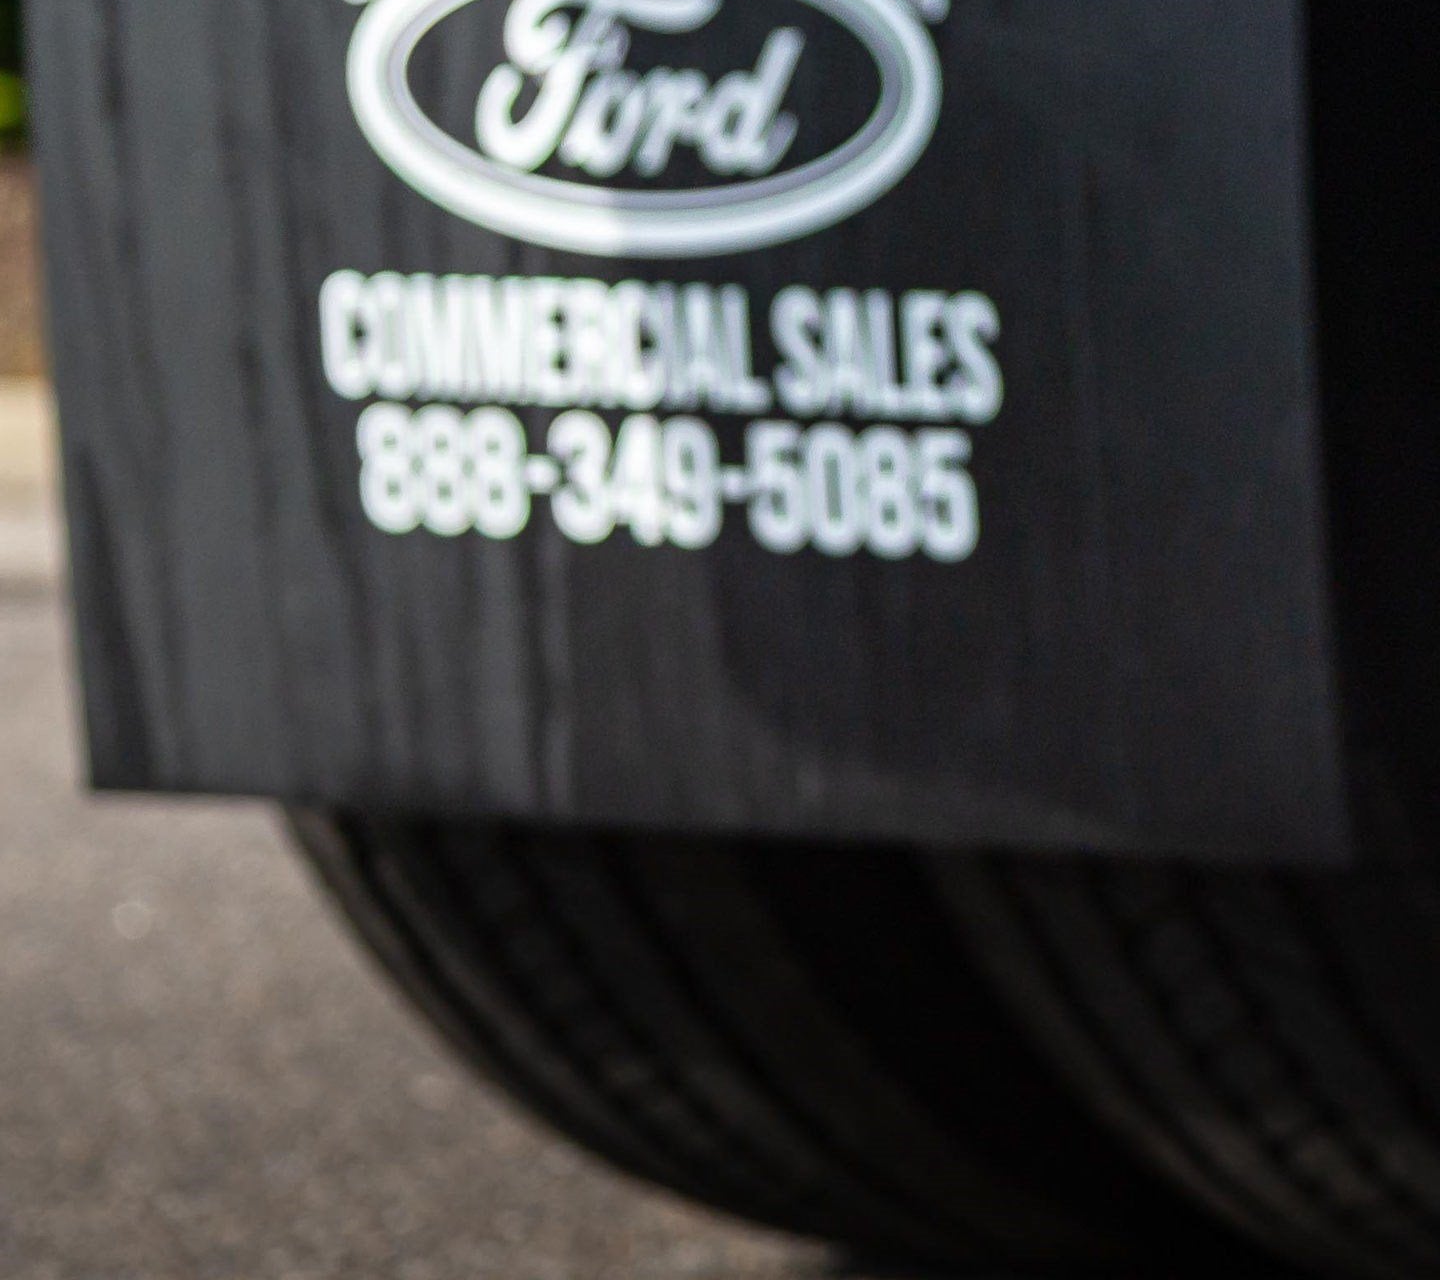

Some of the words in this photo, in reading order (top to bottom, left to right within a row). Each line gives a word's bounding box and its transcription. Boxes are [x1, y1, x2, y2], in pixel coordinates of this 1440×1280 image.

[319, 268, 772, 413] COMMERCIAL
[769, 285, 1004, 425] SALES
[357, 401, 980, 562] 888-349-5085
